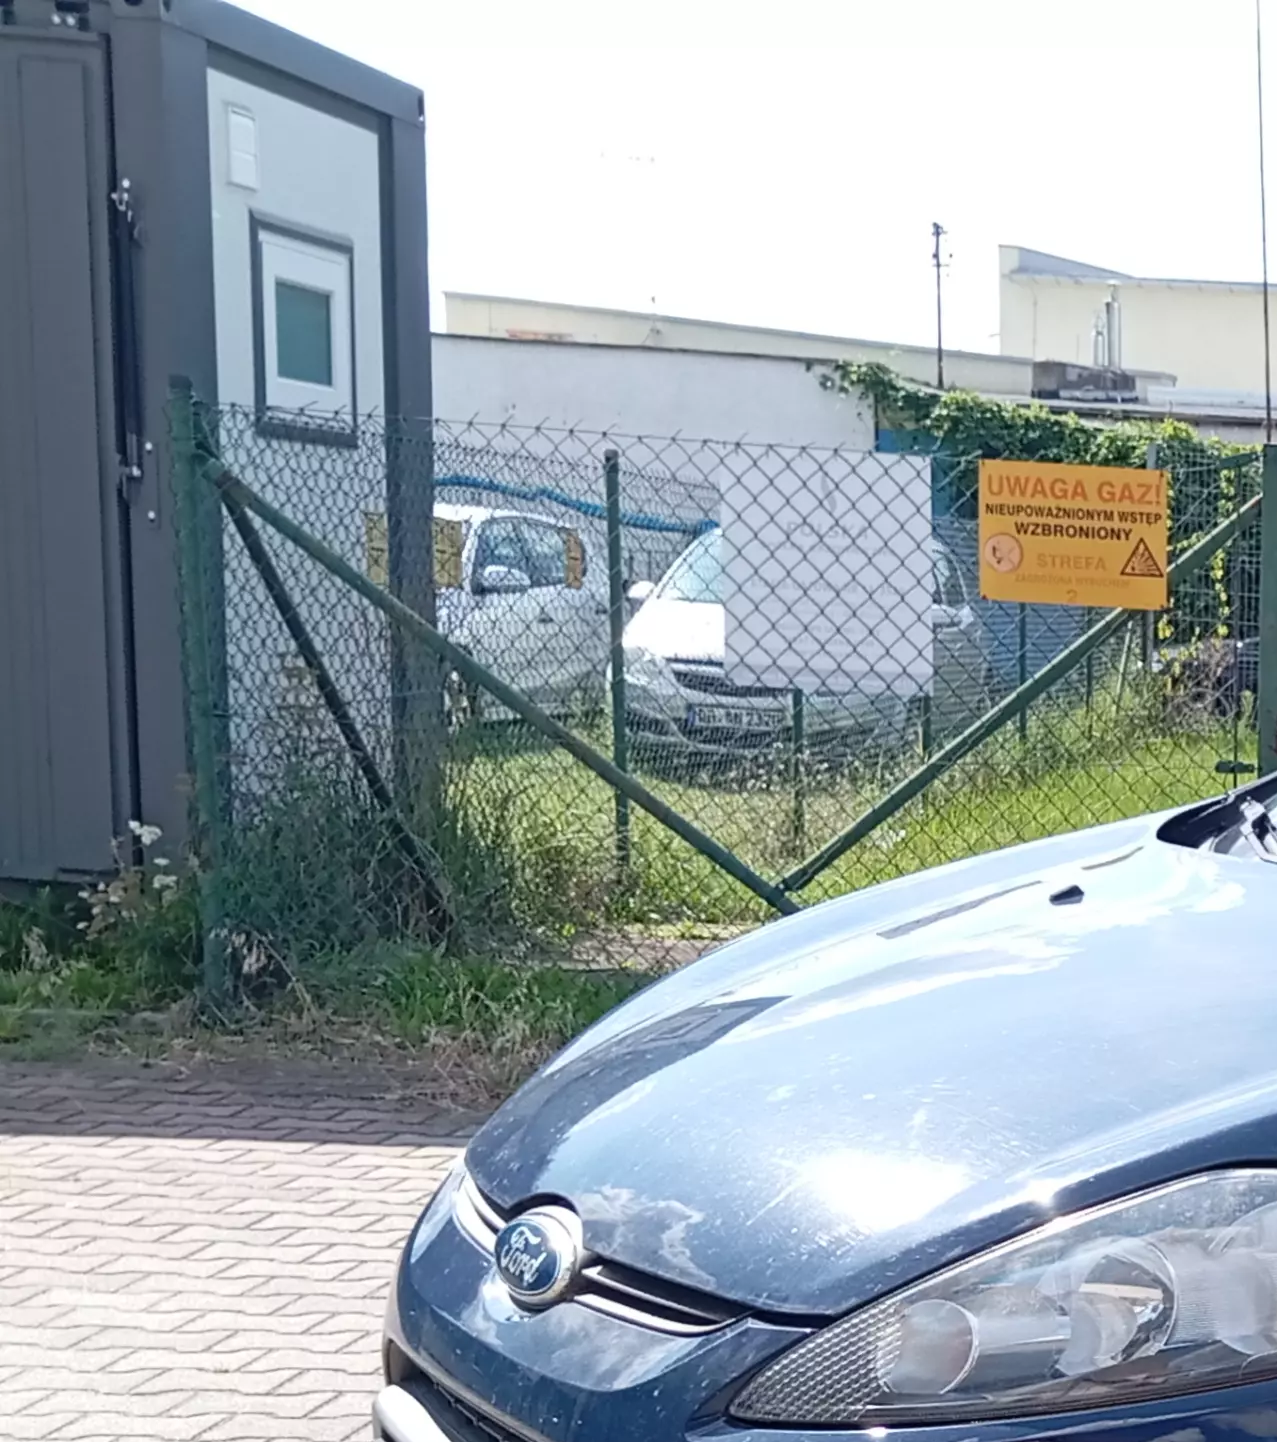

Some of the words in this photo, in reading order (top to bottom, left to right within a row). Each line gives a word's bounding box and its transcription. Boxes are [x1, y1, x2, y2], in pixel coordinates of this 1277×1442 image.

[987, 473, 1089, 502] UWAGA
[1097, 480, 1161, 506] GAZ!
[985, 503, 1115, 522] NIEUPOWAŻNIONYM
[1117, 511, 1162, 526] WSTĘP
[1014, 521, 1133, 541] WZBRONIONY
[1036, 553, 1107, 571] STREFA
[501, 1226, 547, 1287] Ford
